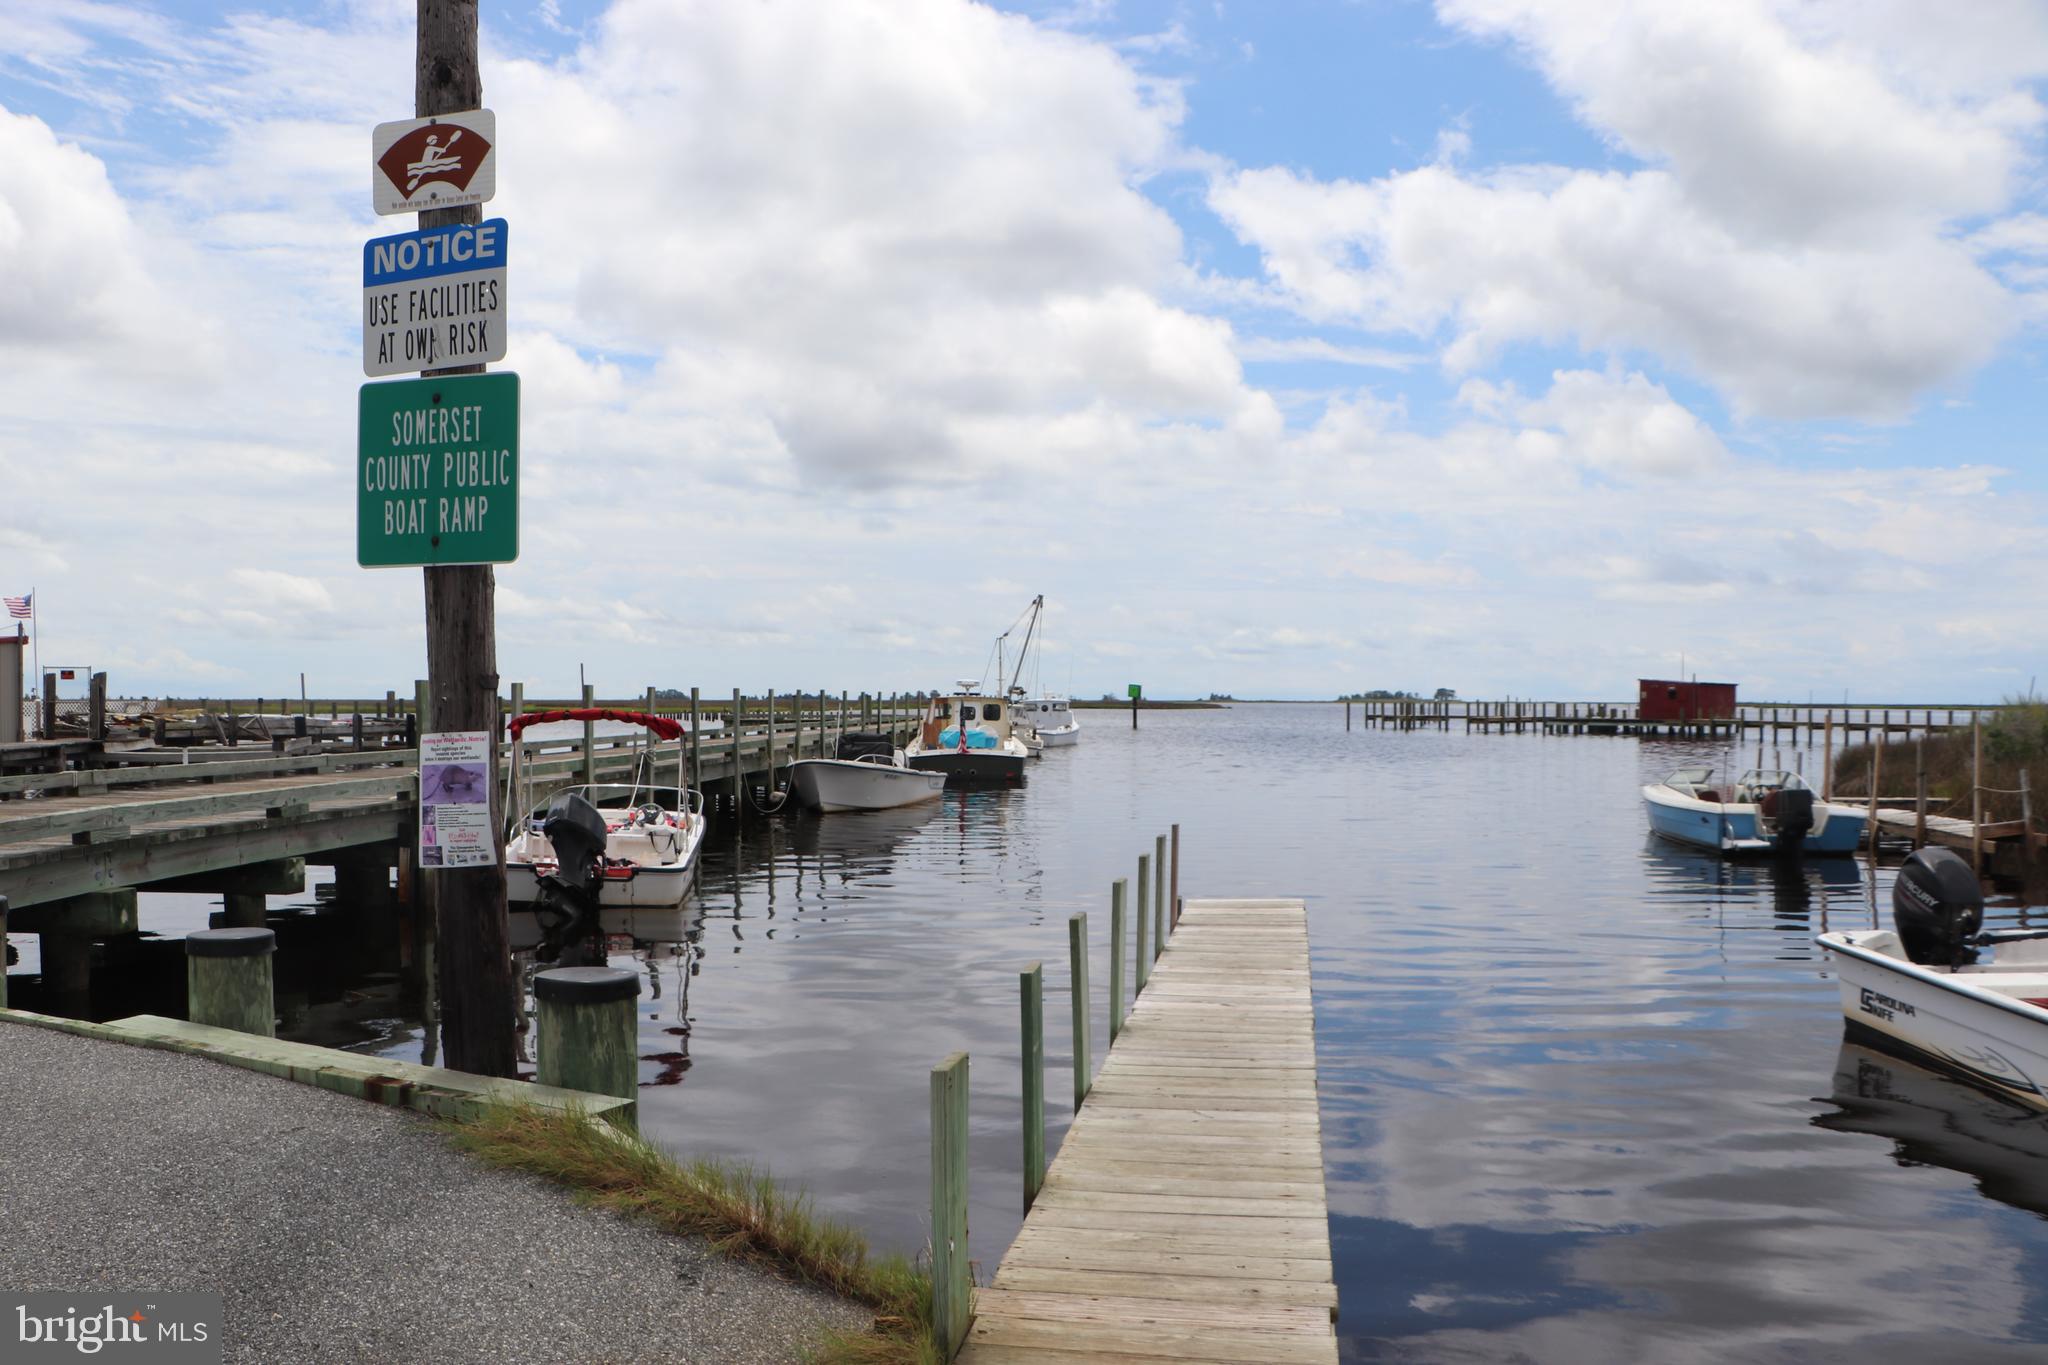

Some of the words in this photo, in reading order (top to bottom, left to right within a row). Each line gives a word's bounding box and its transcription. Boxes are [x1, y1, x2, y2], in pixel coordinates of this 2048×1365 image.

[374, 227, 496, 275] NOTICE
[369, 294, 398, 327] USE
[409, 279, 498, 322] FACILITIES
[378, 332, 395, 364] AT
[449, 320, 488, 356] RISK
[392, 406, 482, 446] SOMERSET
[365, 453, 431, 492] COUNTY
[443, 449, 510, 488] PUBLIC
[384, 498, 427, 535] BOAT
[439, 495, 488, 533] RAMP
